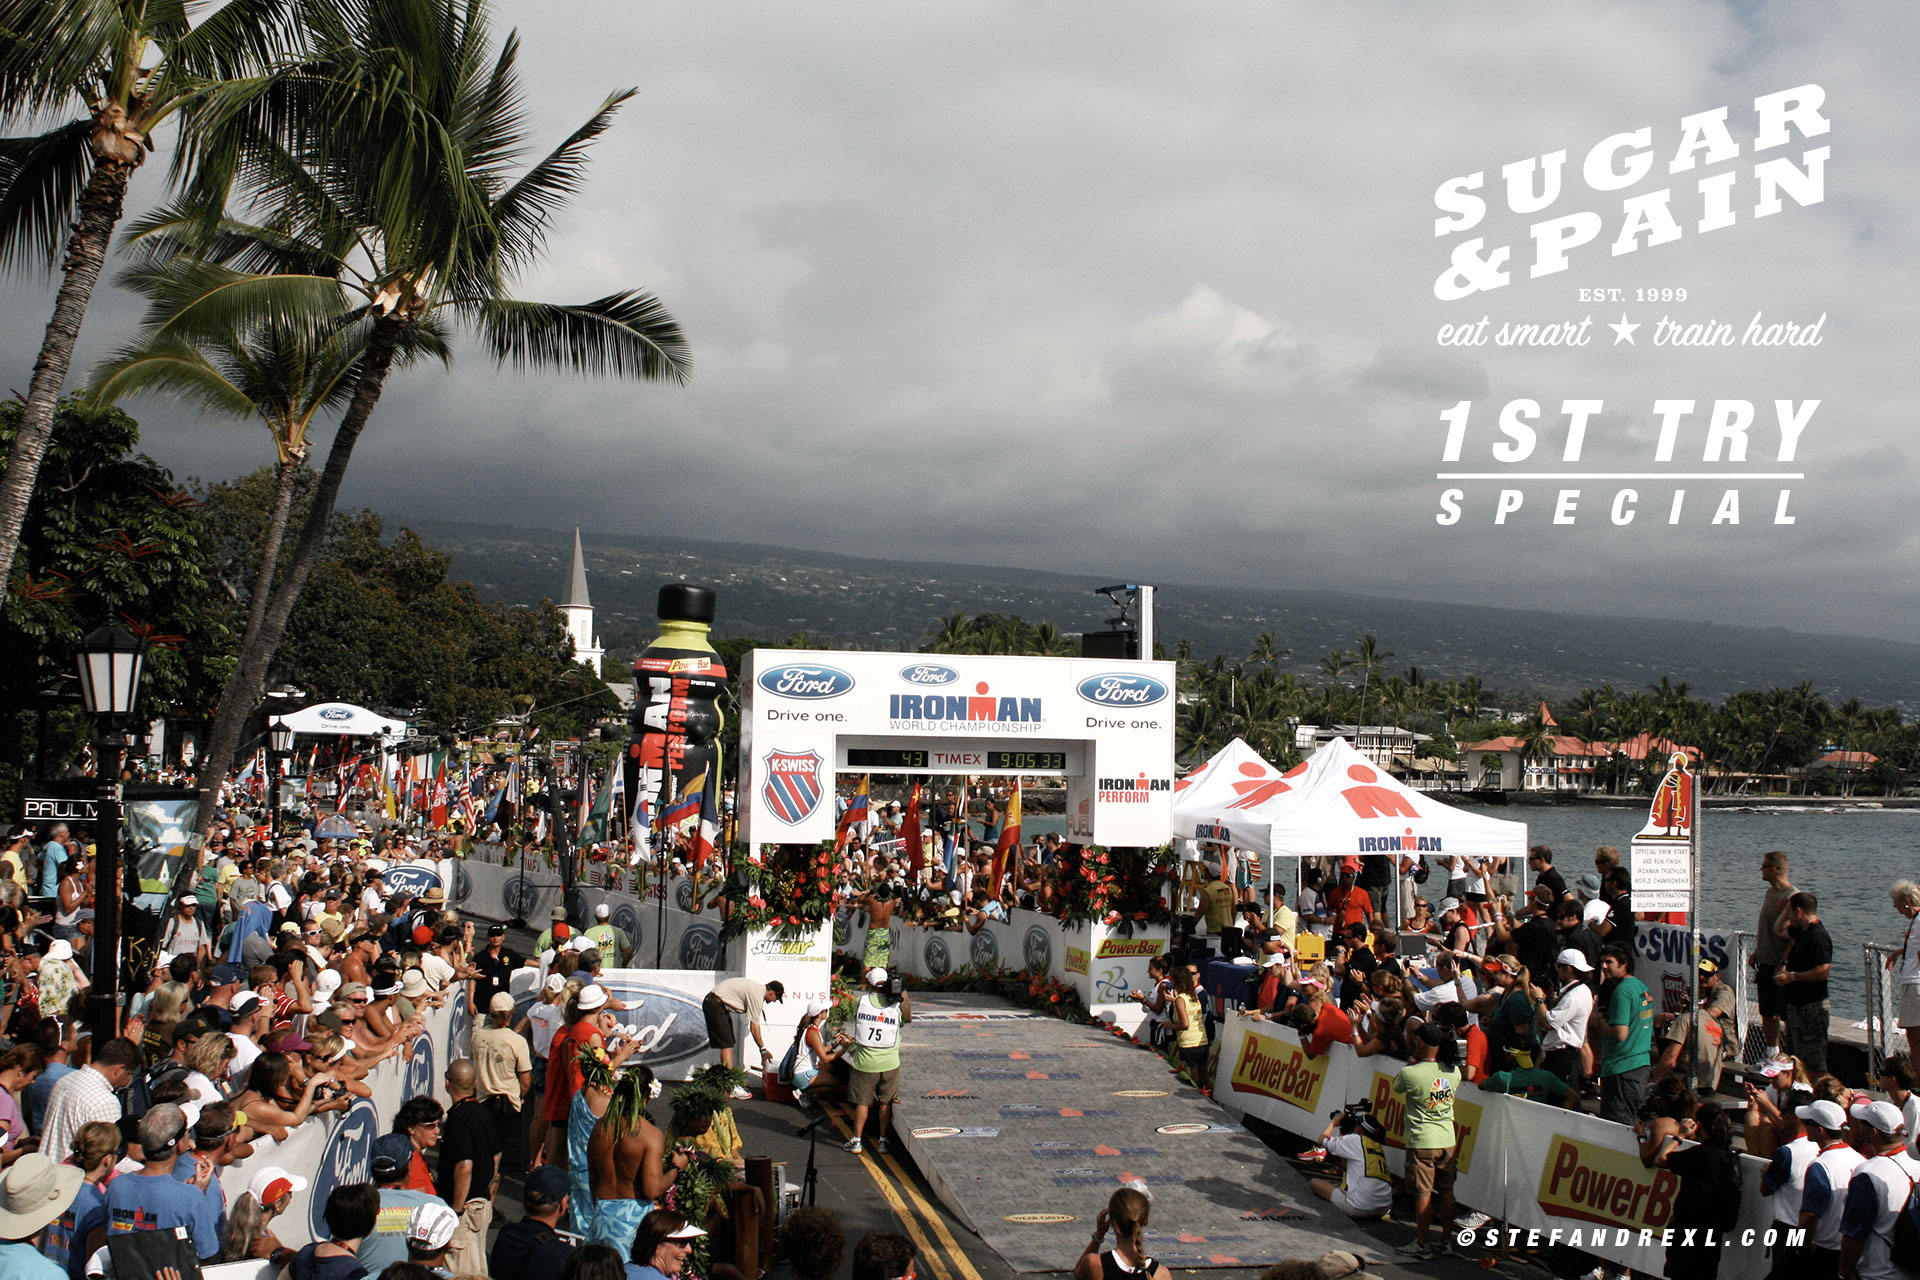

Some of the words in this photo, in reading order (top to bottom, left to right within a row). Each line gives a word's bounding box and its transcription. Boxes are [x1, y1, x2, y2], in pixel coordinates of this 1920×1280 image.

[776, 667, 835, 694] Ford
[911, 667, 948, 684] Ford
[1095, 677, 1151, 702] Ford
[890, 681, 1042, 723] IRONMAN
[325, 708, 347, 720] Ford
[767, 709, 809, 722] Drive
[815, 713, 848, 722] one.
[890, 720, 936, 732] WORLD
[939, 721, 1042, 733] CHAMPIONSHIP
[1086, 717, 1126, 729] Drive
[1131, 720, 1162, 730] one.
[902, 752, 923, 766] 43
[935, 753, 982, 765] TIMEX
[1098, 772, 1170, 791] IRONMAN
[1098, 791, 1150, 803] PERFORM
[25, 801, 82, 817] PAUL
[1359, 827, 1443, 852] IRONMAN
[391, 871, 430, 898] Ford
[751, 940, 815, 955] SUBWAY
[1101, 940, 1160, 954] PowerBar
[782, 991, 826, 1000] ANUS
[858, 1012, 896, 1025] IRONMAN
[868, 1027, 882, 1042] 75
[1238, 1036, 1321, 1102] PowerBar
[1430, 1089, 1451, 1101] NBC
[1549, 1142, 1680, 1228] PowerB
[113, 1206, 157, 1222] IRONMAN
[1240, 1215, 1310, 1223] MOHAWK
